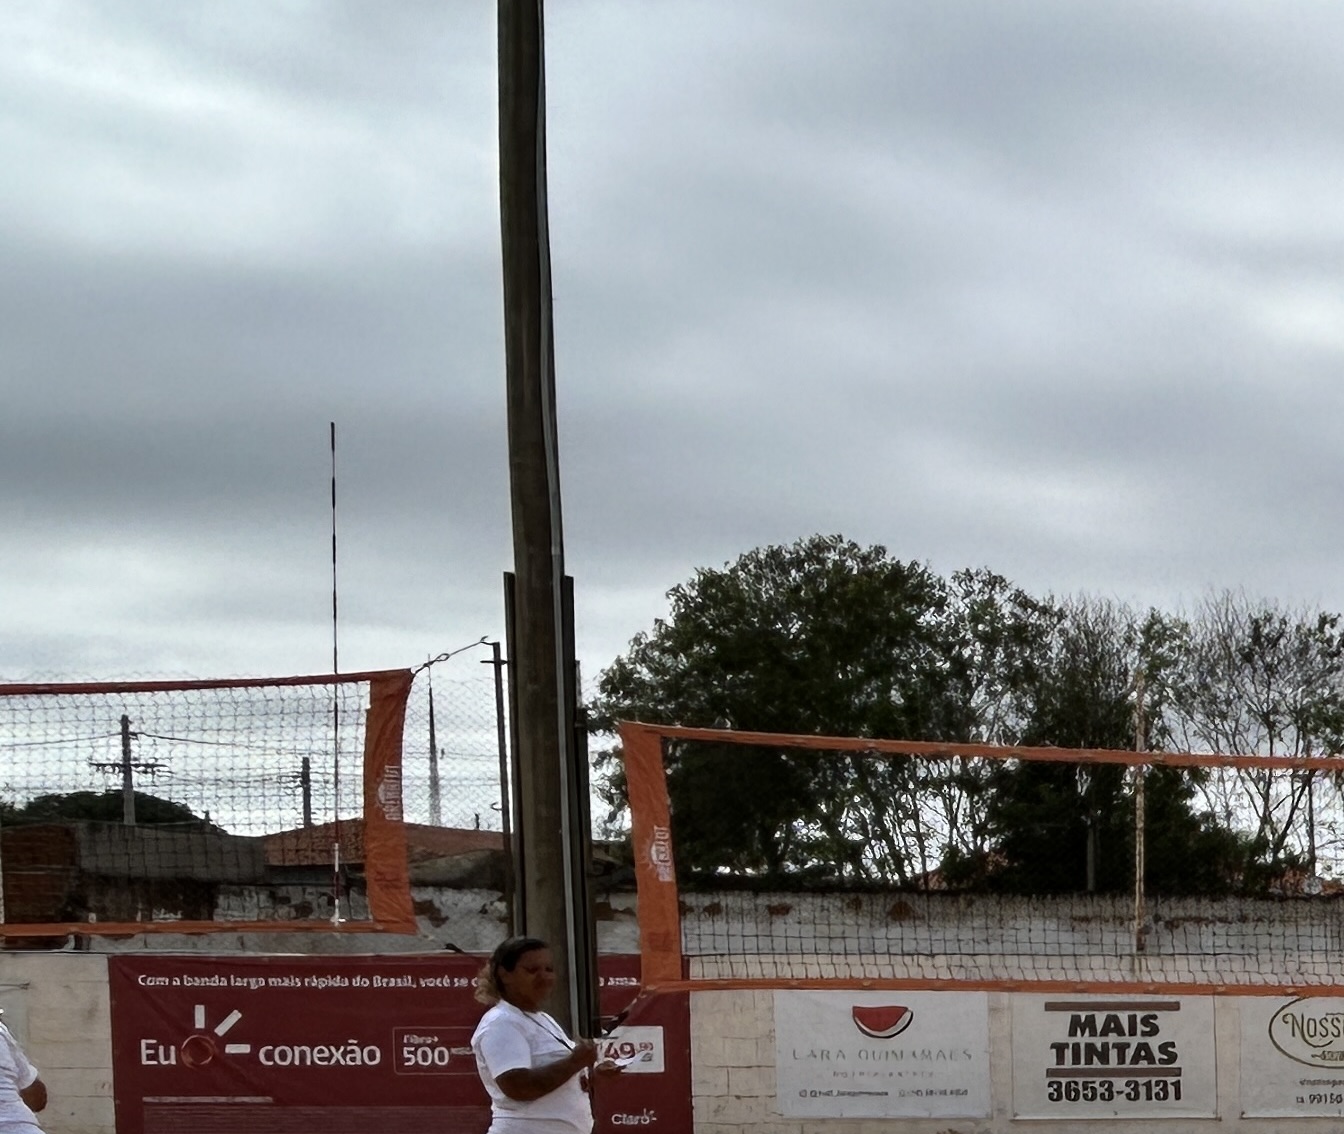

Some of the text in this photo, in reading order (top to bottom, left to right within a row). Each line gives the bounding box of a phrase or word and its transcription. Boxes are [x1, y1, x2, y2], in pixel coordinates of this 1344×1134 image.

[269, 974, 301, 987] mais
[352, 974, 370, 988] do
[454, 977, 469, 988] se
[1068, 1013, 1160, 1037] MAIS
[140, 1039, 381, 1066] Eu conexão
[403, 1046, 450, 1066] 500
[1050, 1041, 1179, 1065] TINTAS
[1047, 1079, 1182, 1102] 3653-3131
[611, 1112, 650, 1126] Claro
